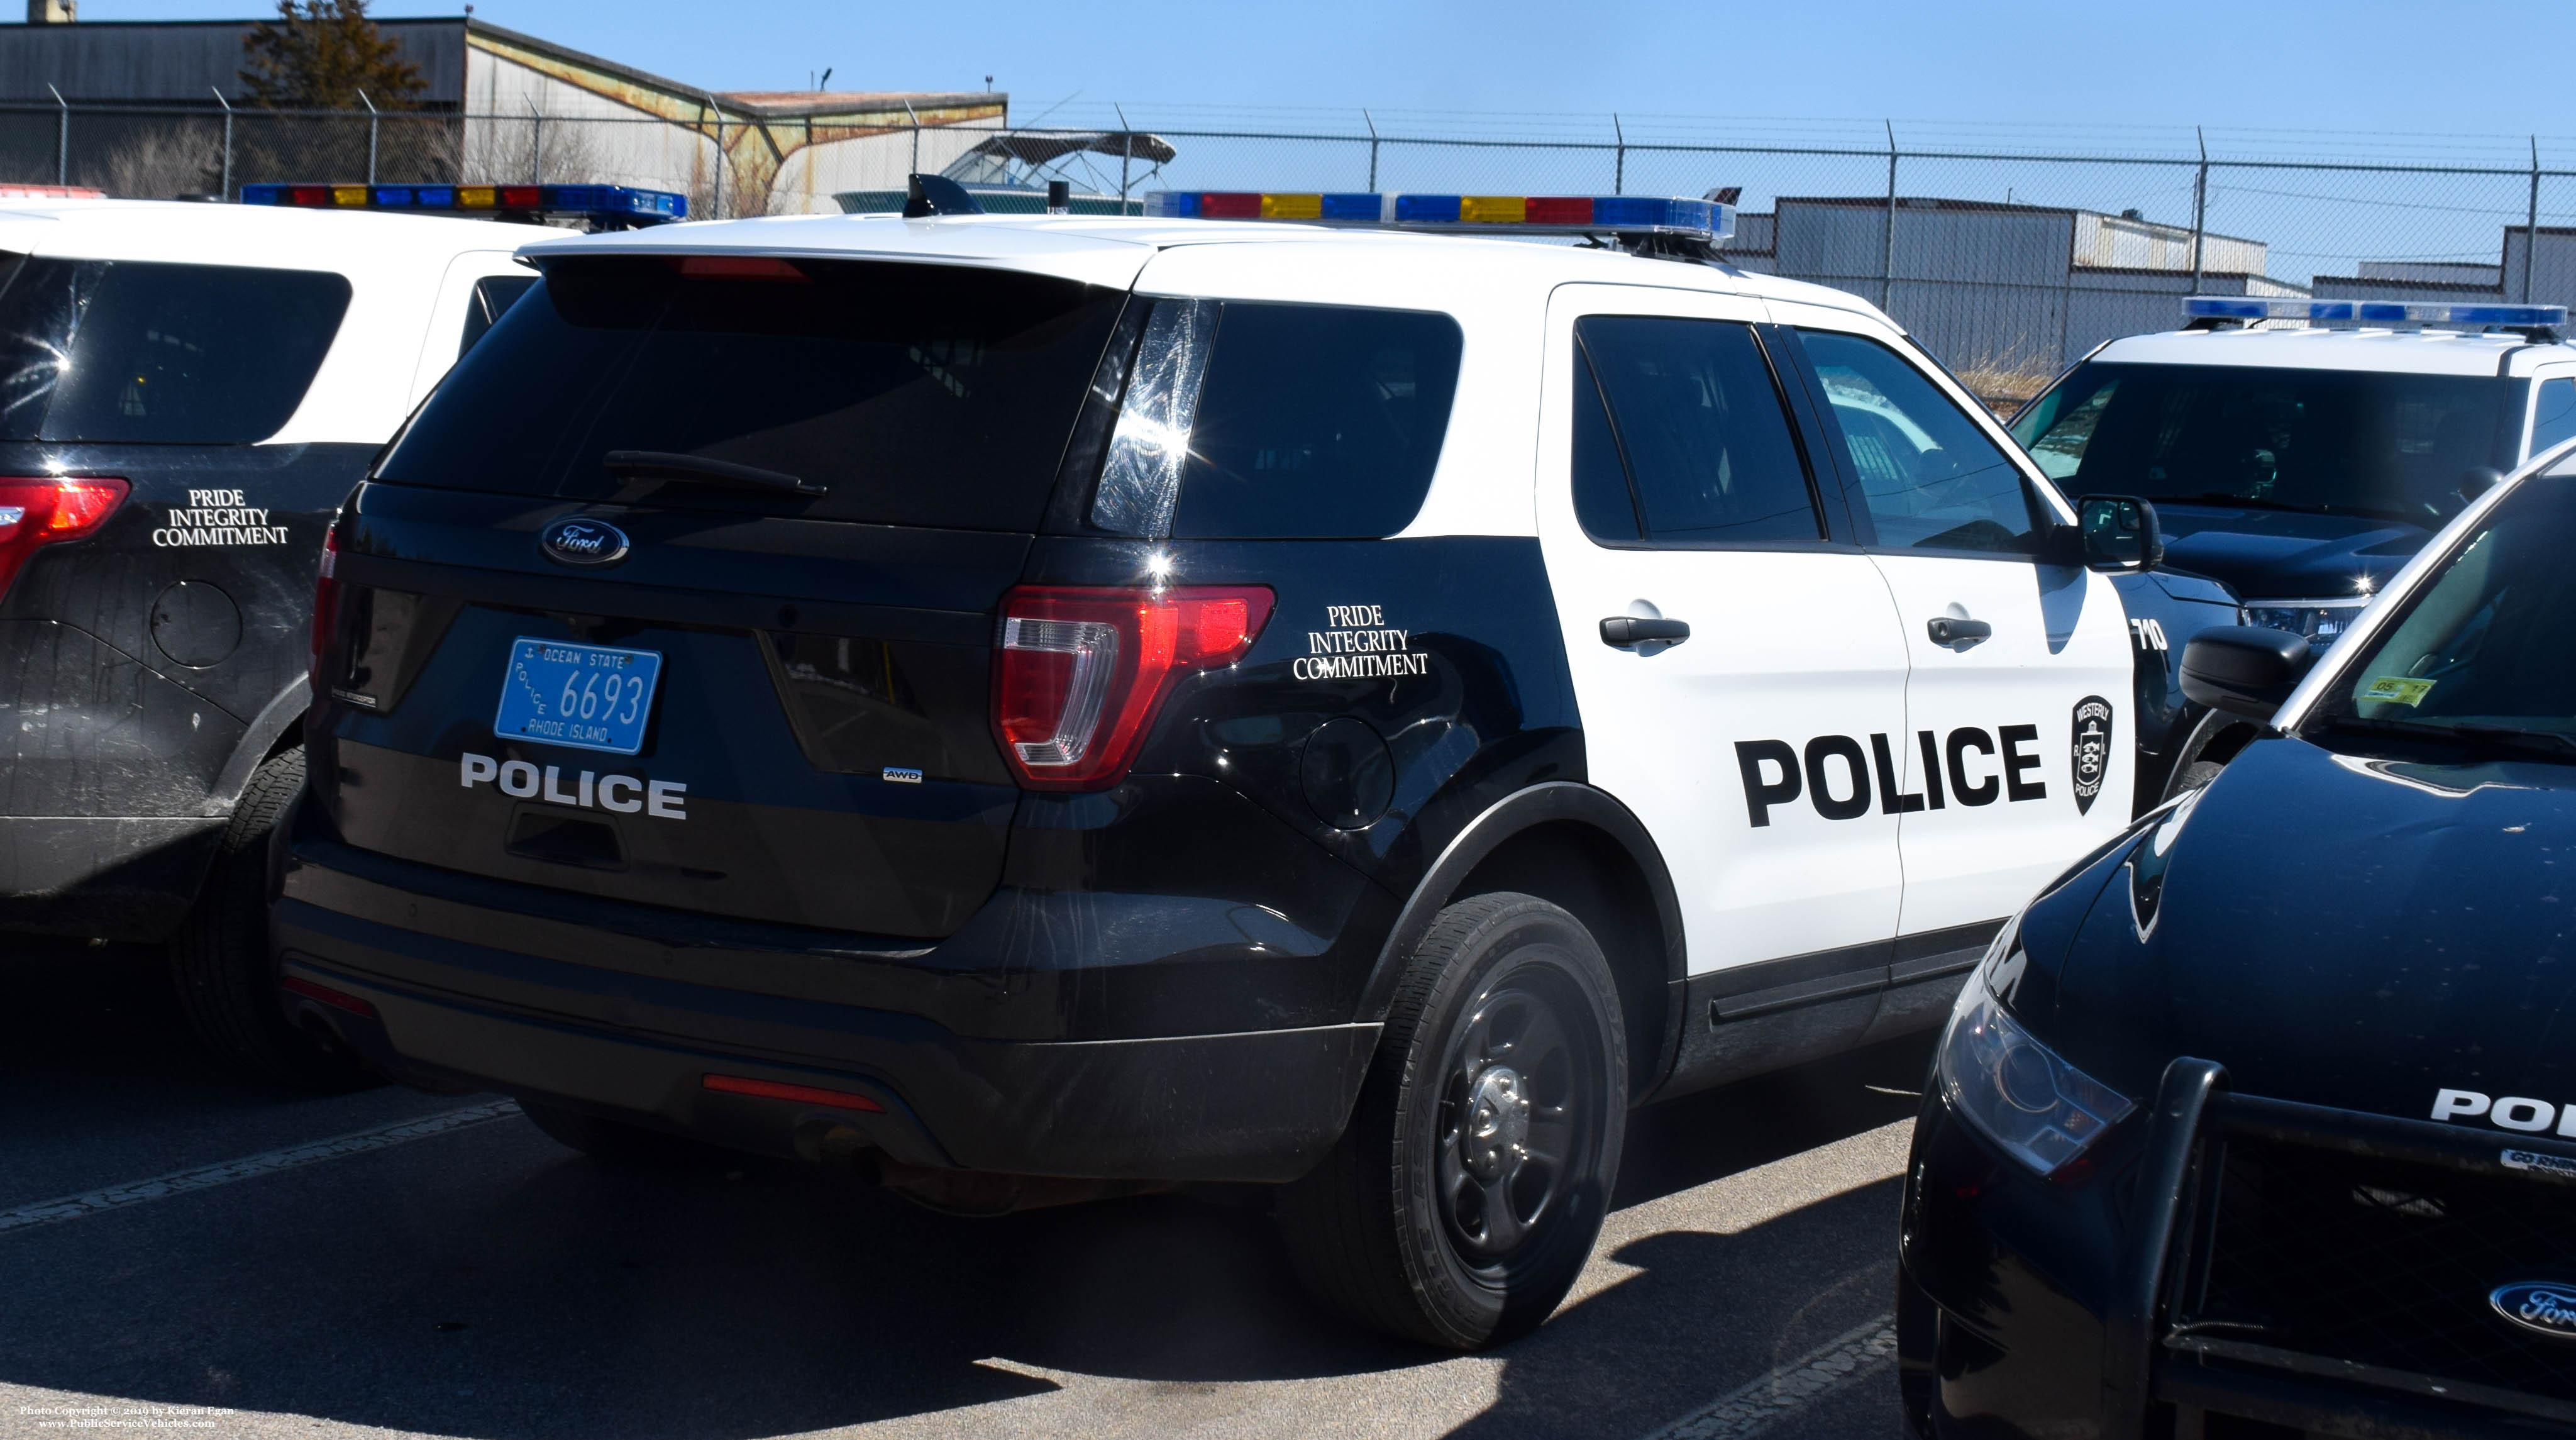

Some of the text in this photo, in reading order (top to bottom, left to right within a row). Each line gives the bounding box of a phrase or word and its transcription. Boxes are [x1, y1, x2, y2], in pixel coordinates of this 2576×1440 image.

[189, 489, 246, 507] PRIDE
[168, 508, 268, 526] INTEGRITY
[152, 526, 289, 547] COMMITMENT
[557, 525, 604, 553] Ford
[1327, 605, 1385, 627] PRIDE
[1308, 629, 1408, 654] INTEGRITY
[2130, 618, 2168, 650] 710
[544, 648, 624, 669] OCEAN STATE
[1293, 653, 1428, 680] COMMITMENT
[516, 662, 546, 715] POLICE
[560, 670, 643, 724] 6693
[2377, 682, 2394, 691] 05
[2077, 702, 2109, 723] WESTERLY
[528, 719, 608, 741] RHODE ISLAND
[461, 752, 687, 820] POLICE
[887, 770, 919, 780] AWD
[1734, 724, 2047, 828] POLICE
[2076, 782, 2099, 797] POLICE
[2520, 1290, 2576, 1327] For
